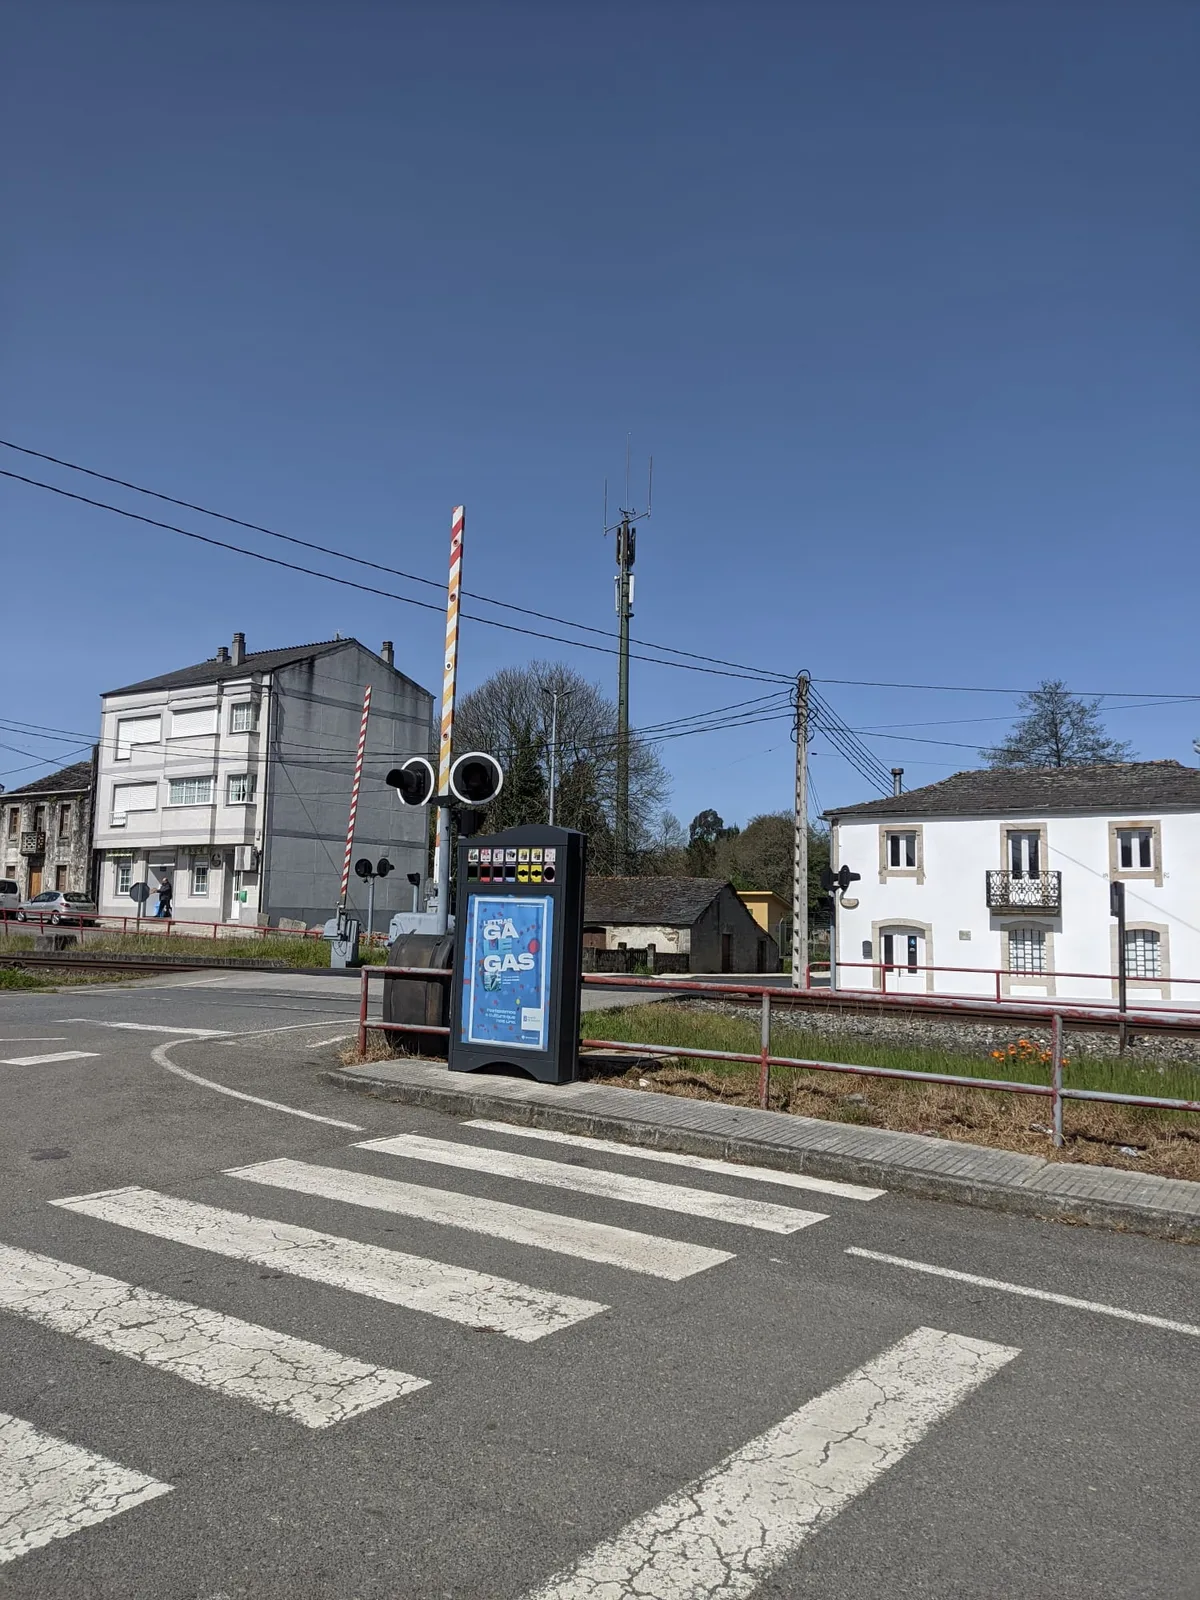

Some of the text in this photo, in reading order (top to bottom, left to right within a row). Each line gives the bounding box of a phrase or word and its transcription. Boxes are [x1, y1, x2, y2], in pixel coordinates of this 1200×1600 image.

[484, 918, 512, 926] LETRAS
[484, 923, 519, 940] GA
[484, 938, 512, 955] LE
[484, 953, 534, 972] GAS
